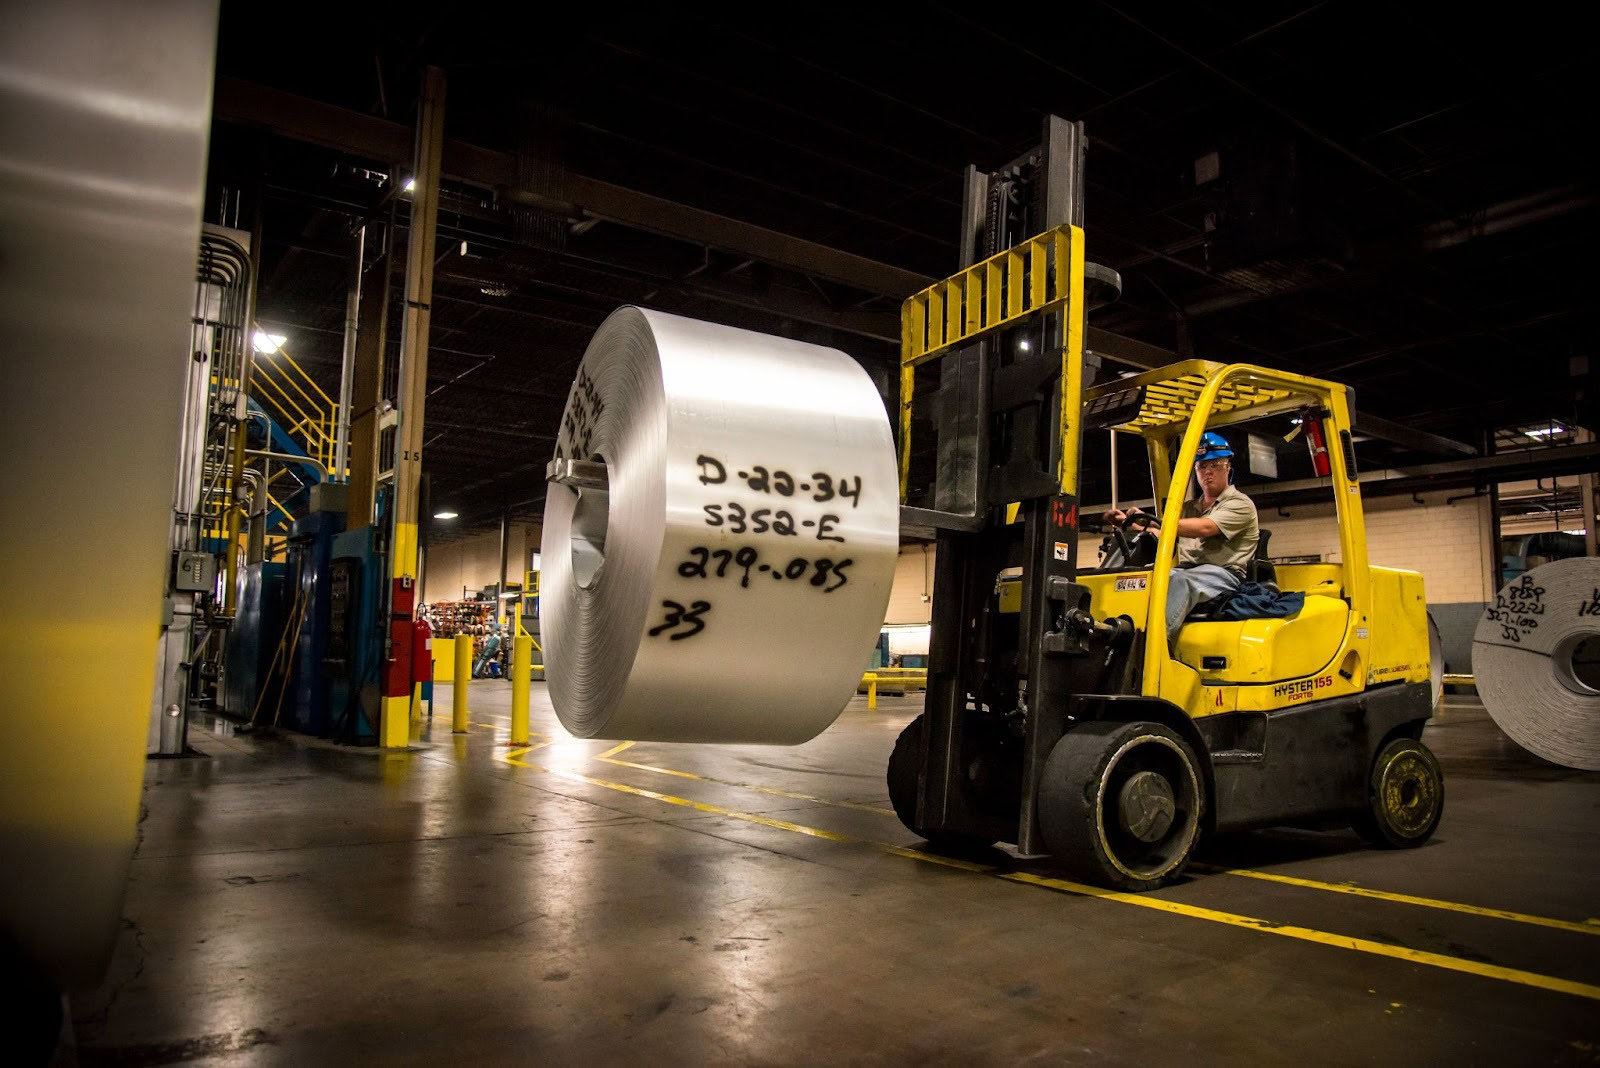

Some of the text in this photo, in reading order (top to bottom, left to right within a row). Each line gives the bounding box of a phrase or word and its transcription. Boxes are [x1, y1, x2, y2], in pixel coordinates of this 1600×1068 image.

[697, 454, 862, 508] D-22-34
[648, 599, 712, 641] 33
[1274, 675, 1333, 697] HYSTER 155
[1288, 690, 1313, 701] FORTIS
